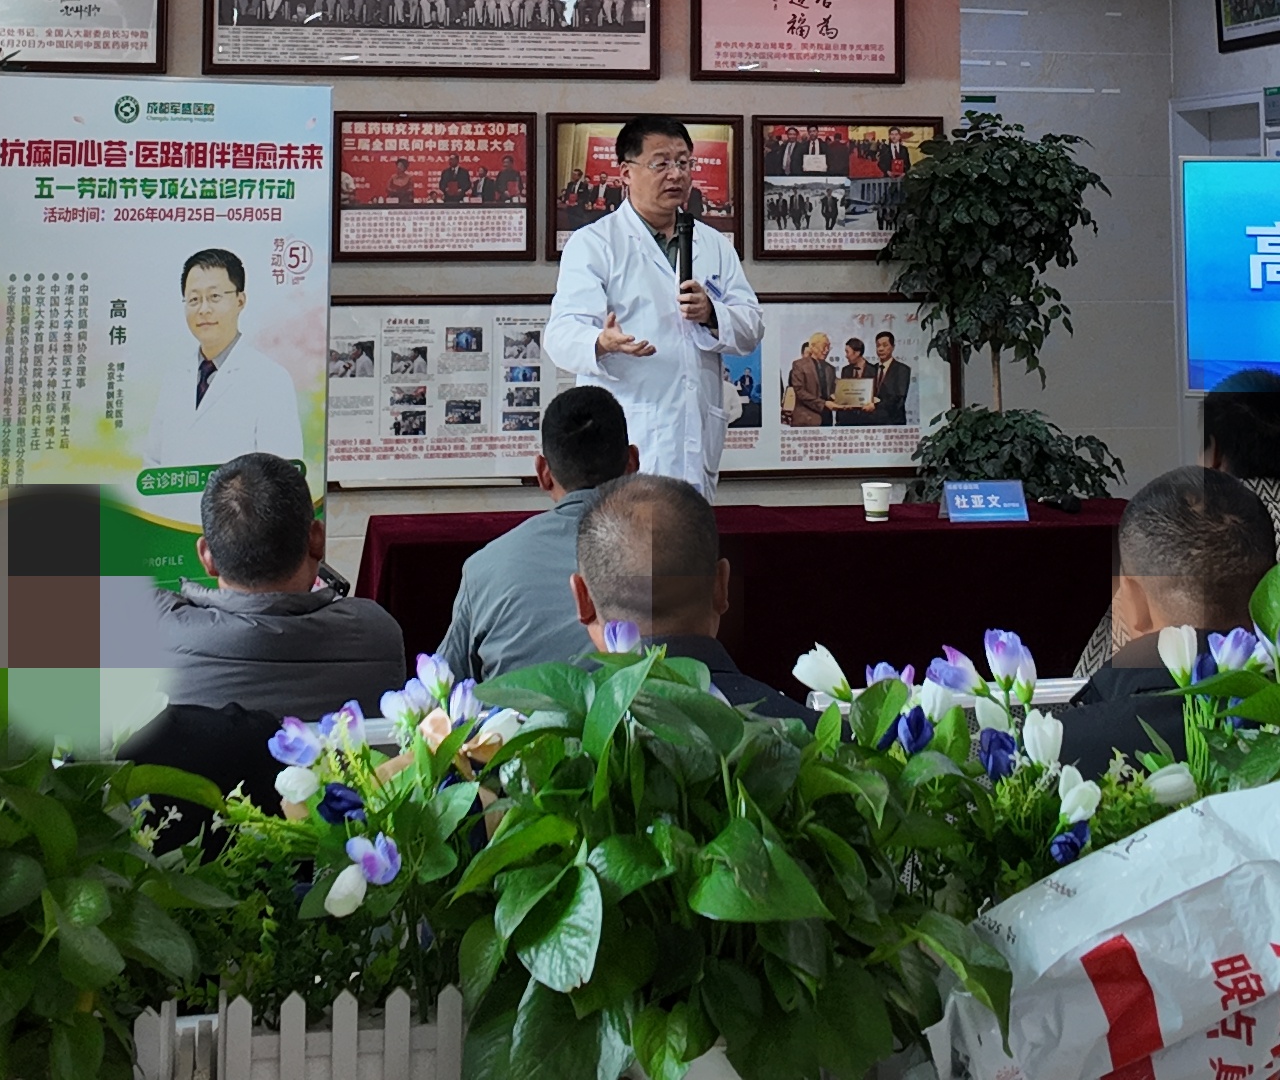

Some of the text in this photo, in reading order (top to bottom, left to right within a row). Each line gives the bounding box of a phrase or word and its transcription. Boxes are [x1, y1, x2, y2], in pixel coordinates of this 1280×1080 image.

[34, 176, 296, 200] 五一劳动节专项公益诊疗行动
[109, 299, 127, 345] 高伟
[954, 494, 1002, 509] 杜亚文
